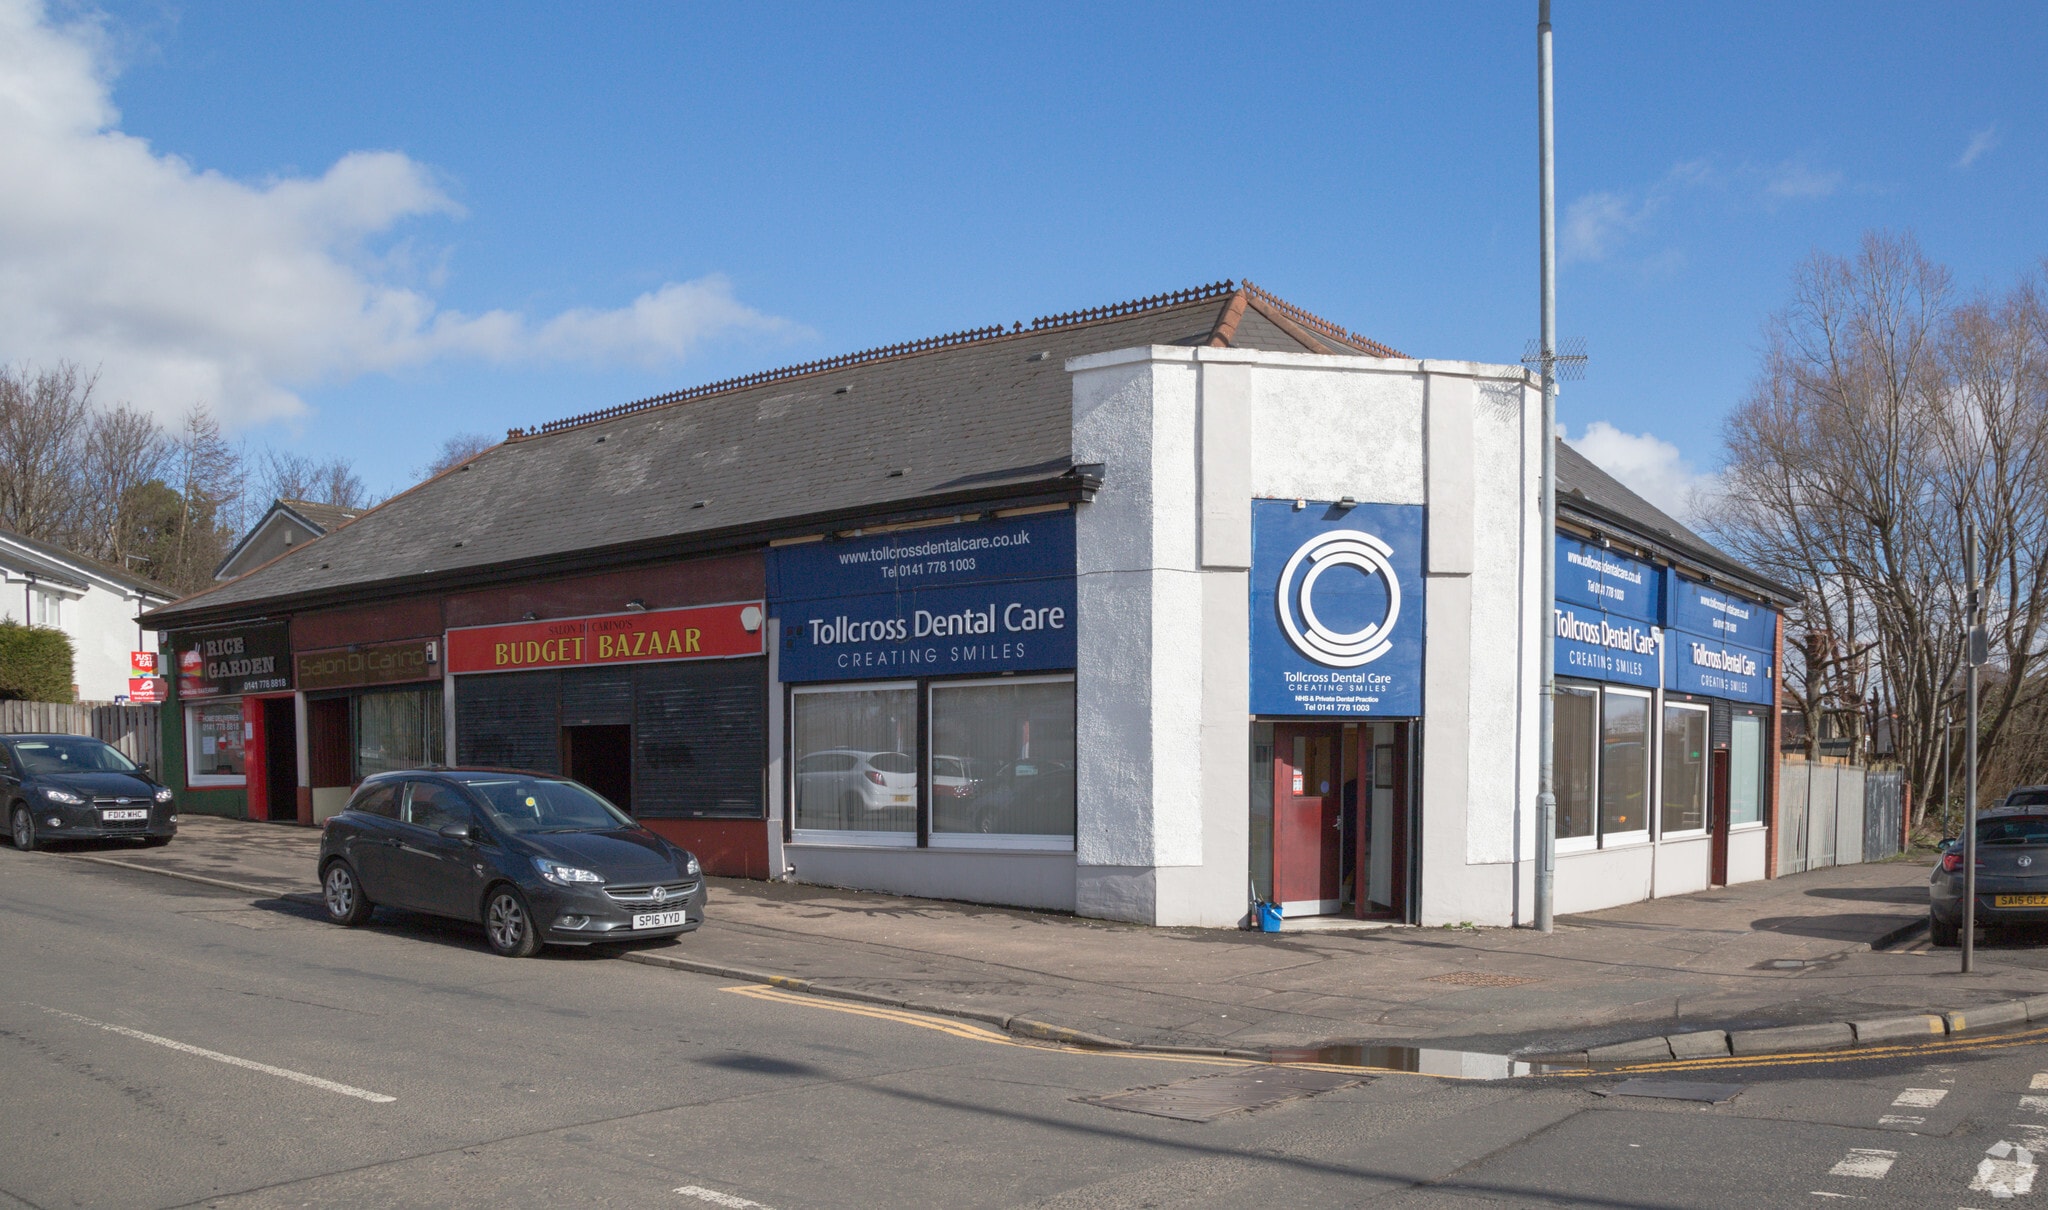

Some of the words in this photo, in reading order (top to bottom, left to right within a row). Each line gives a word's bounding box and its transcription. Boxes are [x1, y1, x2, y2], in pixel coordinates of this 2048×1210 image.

[839, 530, 1031, 565] www.tollcrossdentalcare.co.uk
[881, 566, 898, 579] Tel
[899, 563, 924, 577] 0141
[927, 561, 947, 574] 778
[950, 558, 976, 572] 1003
[548, 624, 577, 636] SALON
[592, 619, 633, 634] CARINO'S
[809, 615, 907, 645] Tollcross
[914, 603, 996, 637] Dental
[1003, 603, 1065, 632] Care
[1554, 609, 1600, 645] Tollcross
[1601, 621, 1633, 653] Dental
[1633, 629, 1655, 655] Care
[206, 636, 245, 657] RICE
[495, 637, 585, 666] BUDGET
[598, 628, 701, 659] BAZAAR
[837, 648, 938, 668] CREATING
[950, 643, 1025, 663] SMILES
[135, 653, 154, 662] JUST
[1570, 651, 1612, 670] CREATING
[1616, 659, 1642, 677] SMILES
[1692, 643, 1722, 669] Tollcross
[1722, 650, 1742, 674] Dental
[1743, 655, 1756, 676] Care
[208, 656, 276, 679] GARDEN
[243, 681, 258, 691] 0141
[259, 680, 270, 689] 778
[270, 678, 287, 688] 8818
[1284, 672, 1328, 683] Tollcross
[1331, 672, 1365, 683] Dental
[1368, 673, 1391, 684] Care
[1701, 675, 1728, 690] CREATING
[1730, 679, 1748, 693] SMILES
[1288, 684, 1343, 692] CREATING
[1349, 684, 1386, 692] SMILES
[1304, 703, 1316, 711] Tel
[1353, 704, 1370, 712] 1003
[108, 811, 126, 819] FD12
[2001, 896, 2024, 905] SA15
[639, 914, 660, 926] SP16
[663, 913, 680, 925] YYD
